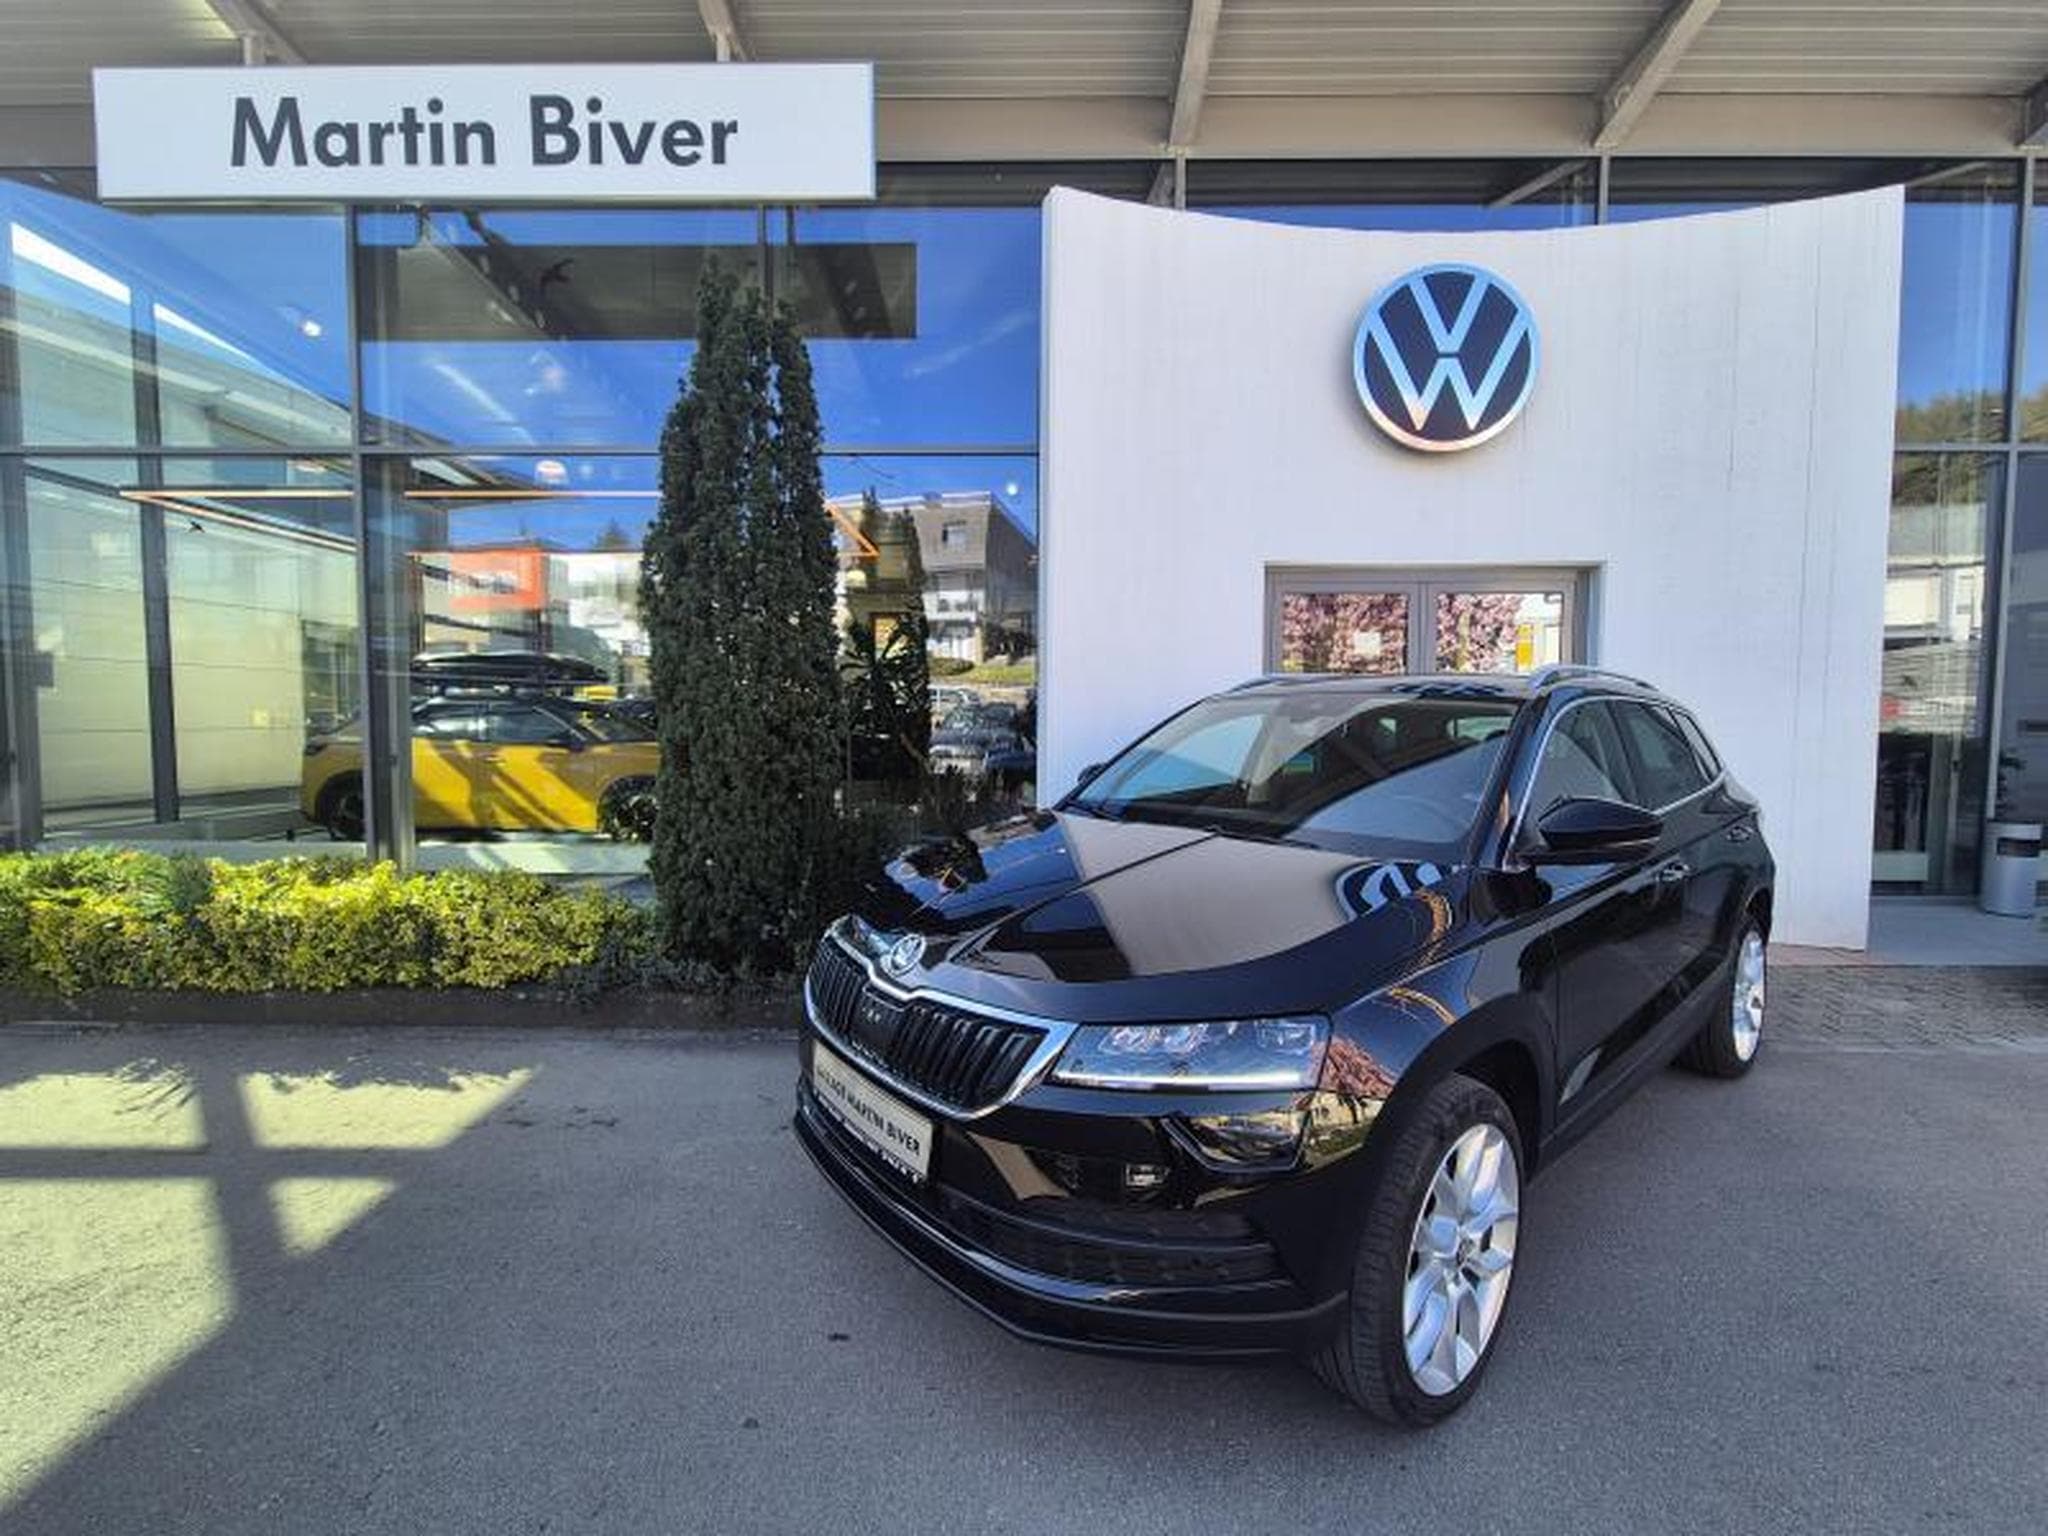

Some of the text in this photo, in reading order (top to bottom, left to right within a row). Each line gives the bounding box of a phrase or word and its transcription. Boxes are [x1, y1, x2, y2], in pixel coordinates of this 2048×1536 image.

[231, 94, 739, 168] Martin Biver
[1363, 265, 1533, 432] VW
[847, 1093, 921, 1156] MARTIN BIVER
